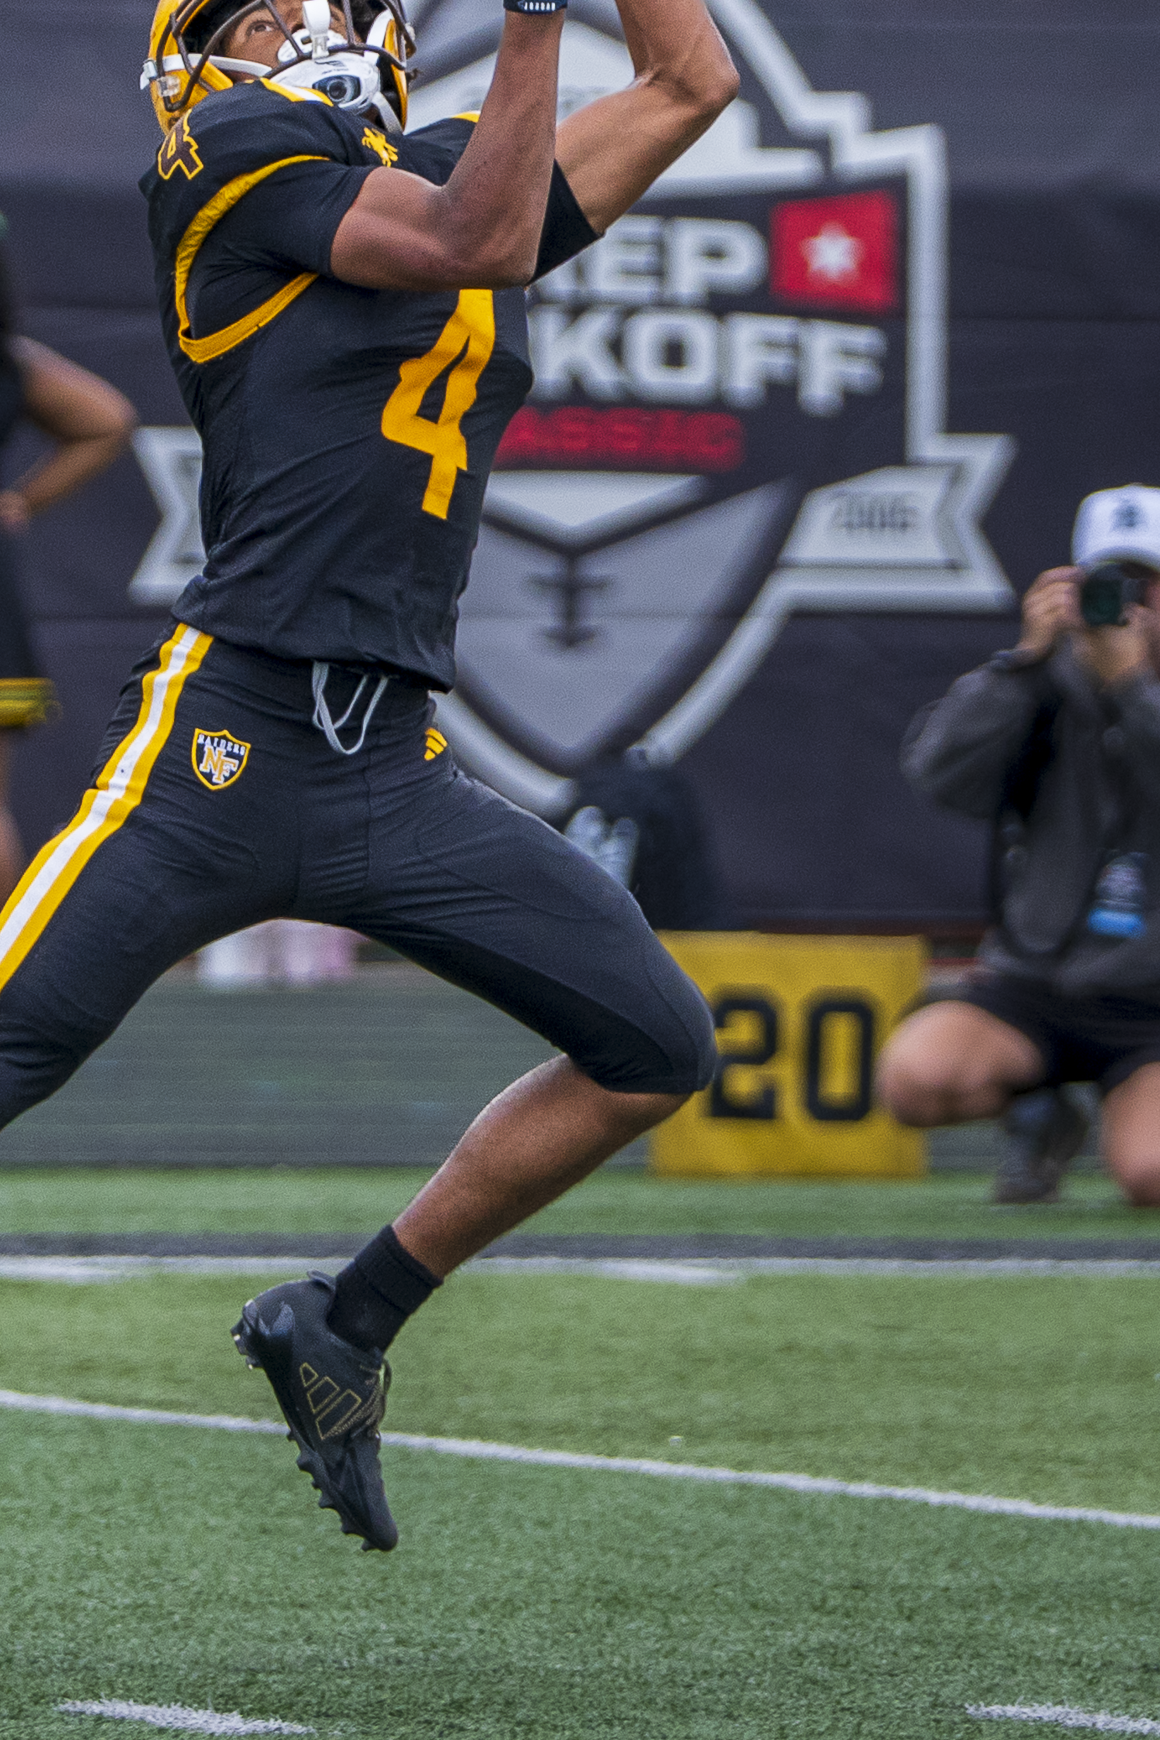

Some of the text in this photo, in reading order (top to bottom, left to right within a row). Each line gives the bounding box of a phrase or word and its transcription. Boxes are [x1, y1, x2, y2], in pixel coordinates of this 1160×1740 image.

[158, 108, 204, 180] 4
[533, 215, 769, 306] EP
[528, 302, 888, 419] KOFF
[381, 289, 495, 520] 4
[493, 406, 746, 471] ASSIC
[197, 733, 246, 756] RAIDERS
[199, 746, 239, 784] NF
[711, 985, 875, 1121] 20
